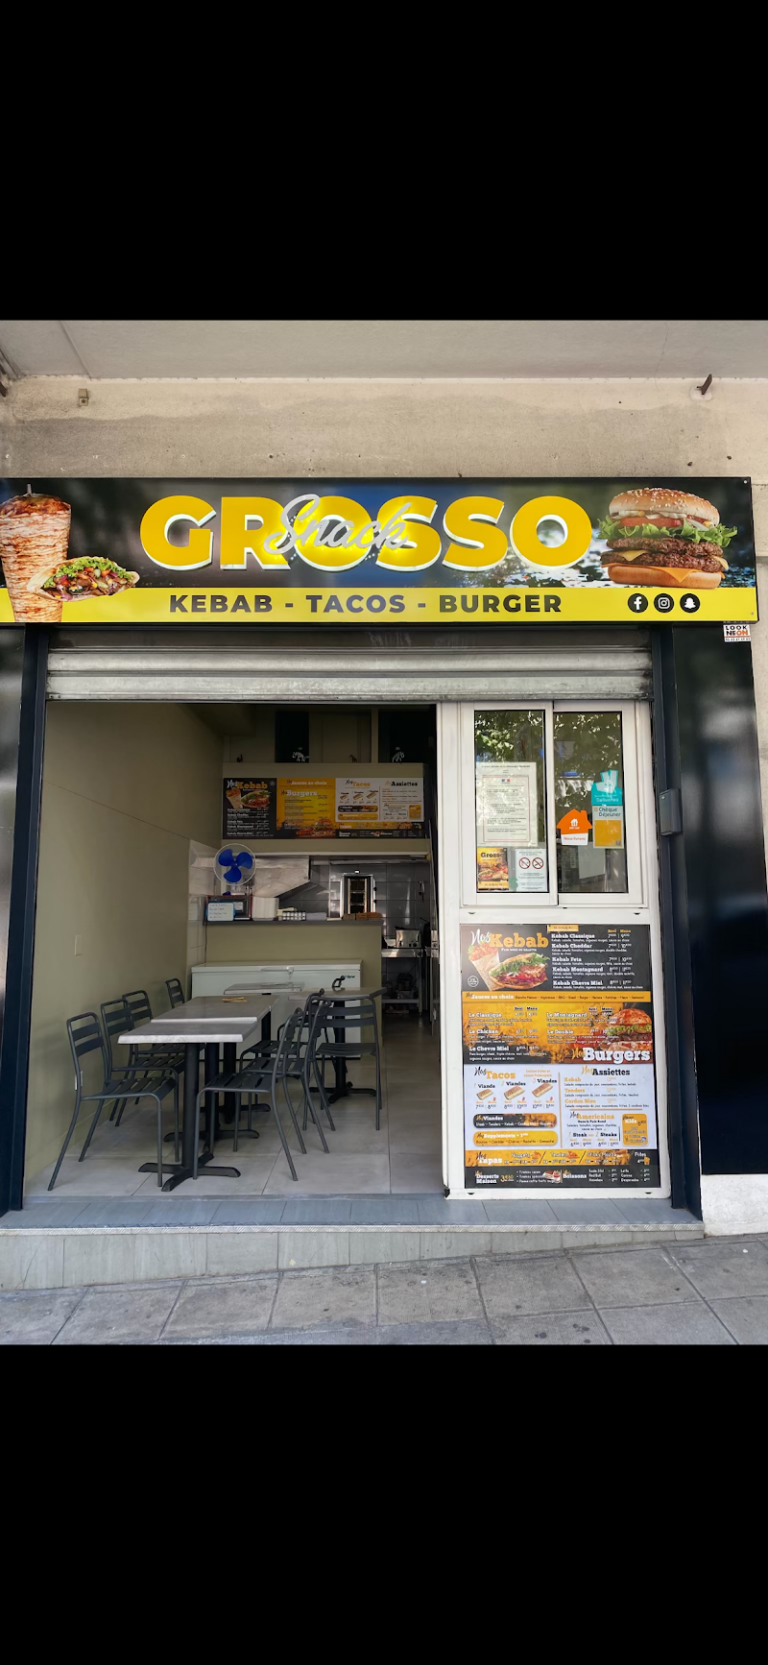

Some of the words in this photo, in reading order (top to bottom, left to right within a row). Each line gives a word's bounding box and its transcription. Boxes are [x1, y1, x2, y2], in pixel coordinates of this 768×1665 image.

[263, 494, 411, 554] Snack
[140, 495, 592, 571] GROSSO
[169, 594, 273, 613] KEBAB
[305, 594, 406, 613] TACOS
[438, 594, 562, 613] BURGER
[236, 781, 269, 789] Kebab
[286, 789, 318, 797] Burgers
[489, 932, 549, 948] Kebab
[582, 1047, 651, 1064] Burgers
[485, 1070, 516, 1079] Tacos
[591, 1068, 631, 1076] Assiettes
